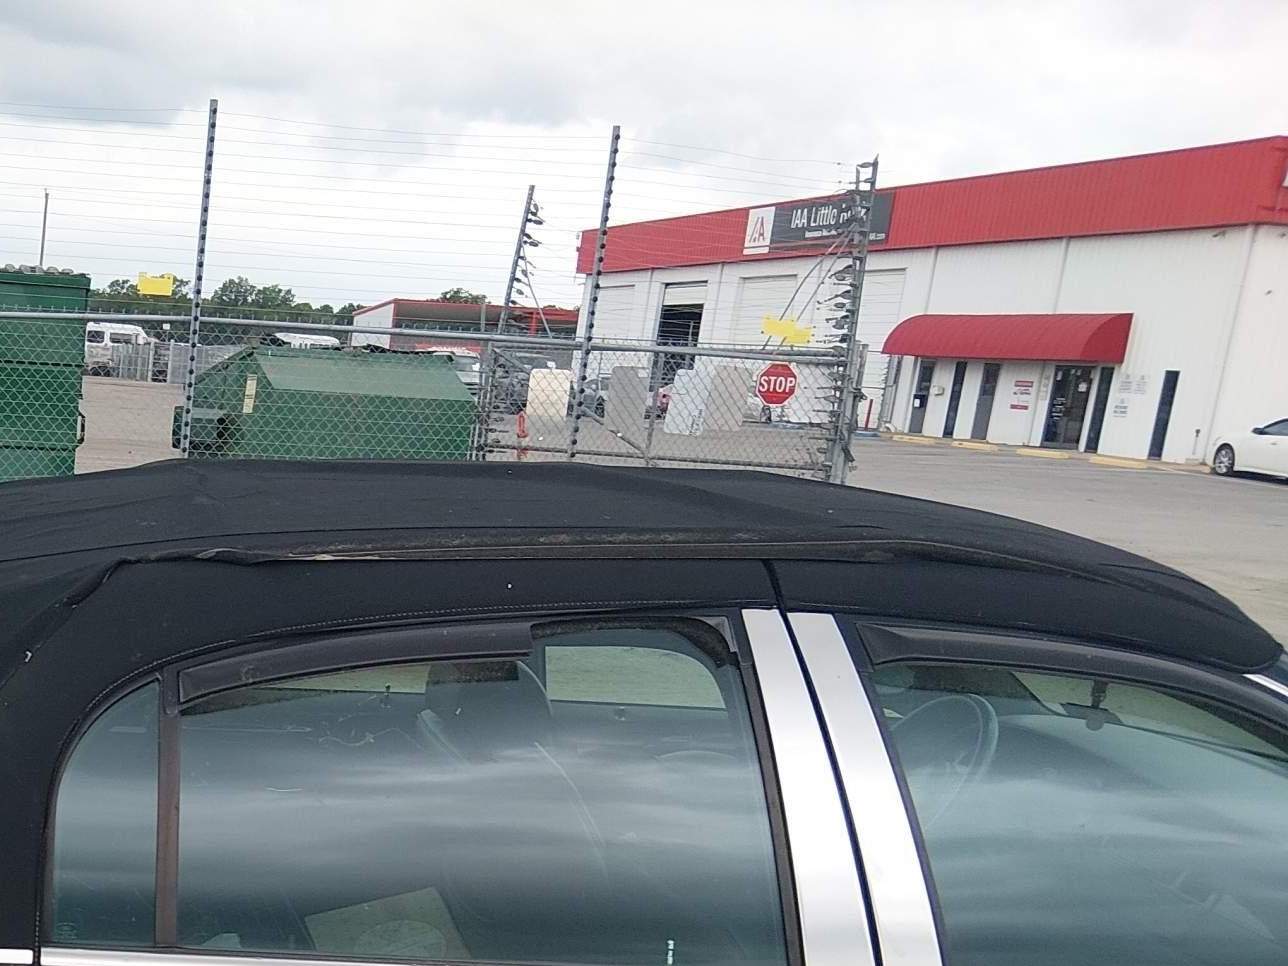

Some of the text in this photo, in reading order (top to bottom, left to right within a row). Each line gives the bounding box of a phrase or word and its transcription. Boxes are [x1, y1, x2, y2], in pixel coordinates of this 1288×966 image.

[791, 207, 808, 229] IAA
[810, 204, 838, 227] Little
[759, 375, 796, 393] STOP
